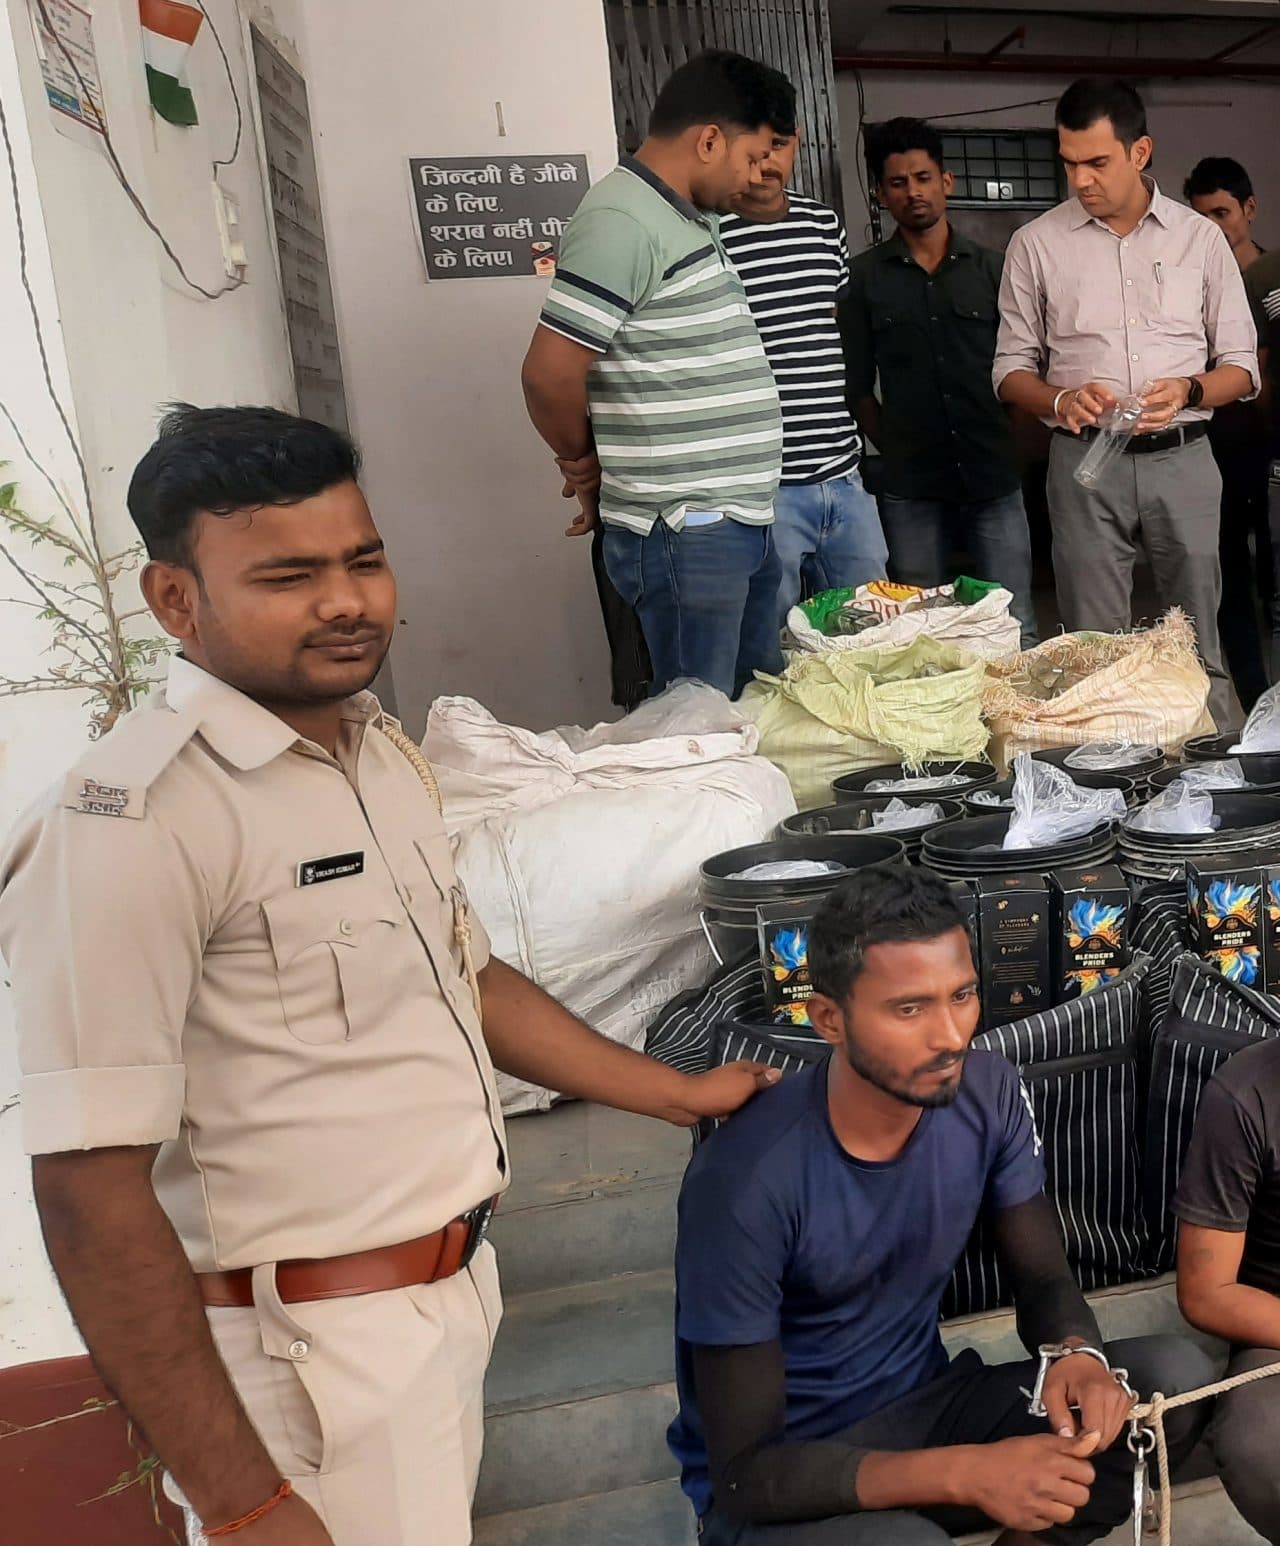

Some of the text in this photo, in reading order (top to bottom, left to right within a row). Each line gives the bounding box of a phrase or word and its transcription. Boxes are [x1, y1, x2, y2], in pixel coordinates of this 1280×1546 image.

[420, 162, 578, 186] जिन्दगी है जीने
[425, 194, 449, 213] के
[430, 222, 486, 242] शराब
[492, 217, 534, 238] नहीं
[434, 248, 458, 268] के
[1213, 930, 1251, 941] BLENDERS
[1221, 938, 1244, 946] PRIDE
[1074, 952, 1114, 961] BLENDERS
[1082, 959, 1106, 967] PRIDE
[792, 991, 813, 1000] PRID
